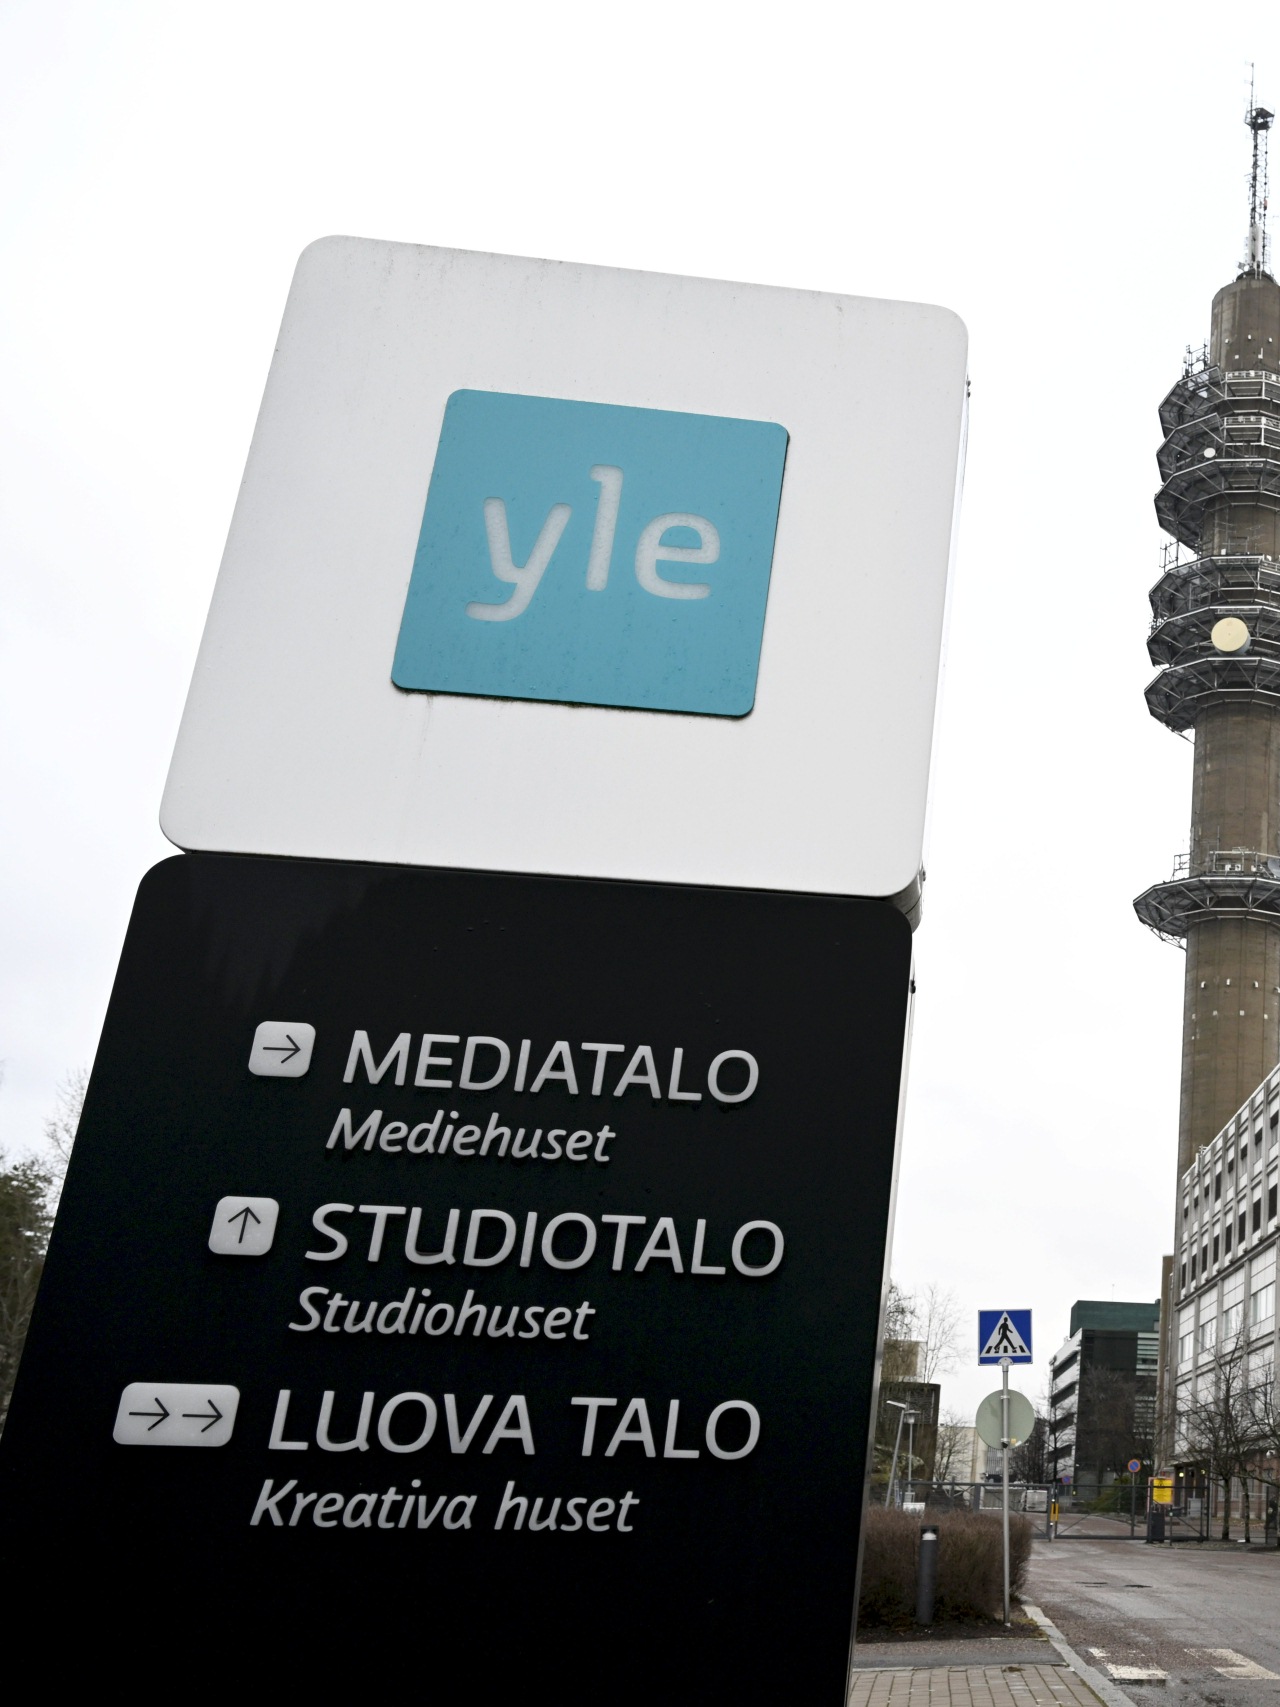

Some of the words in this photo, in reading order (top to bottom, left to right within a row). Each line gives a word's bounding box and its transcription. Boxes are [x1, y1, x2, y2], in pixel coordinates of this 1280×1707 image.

[466, 466, 722, 625] yle
[341, 1028, 761, 1107] MEDIATALO
[325, 1107, 617, 1164] Mediehuset
[303, 1201, 787, 1279] STUDIOTALO
[287, 1285, 597, 1342] Studiohuset
[266, 1388, 536, 1456] LUOVA
[569, 1395, 763, 1462] TALO
[248, 1477, 479, 1532] Kreativa
[493, 1479, 641, 1534] huset
